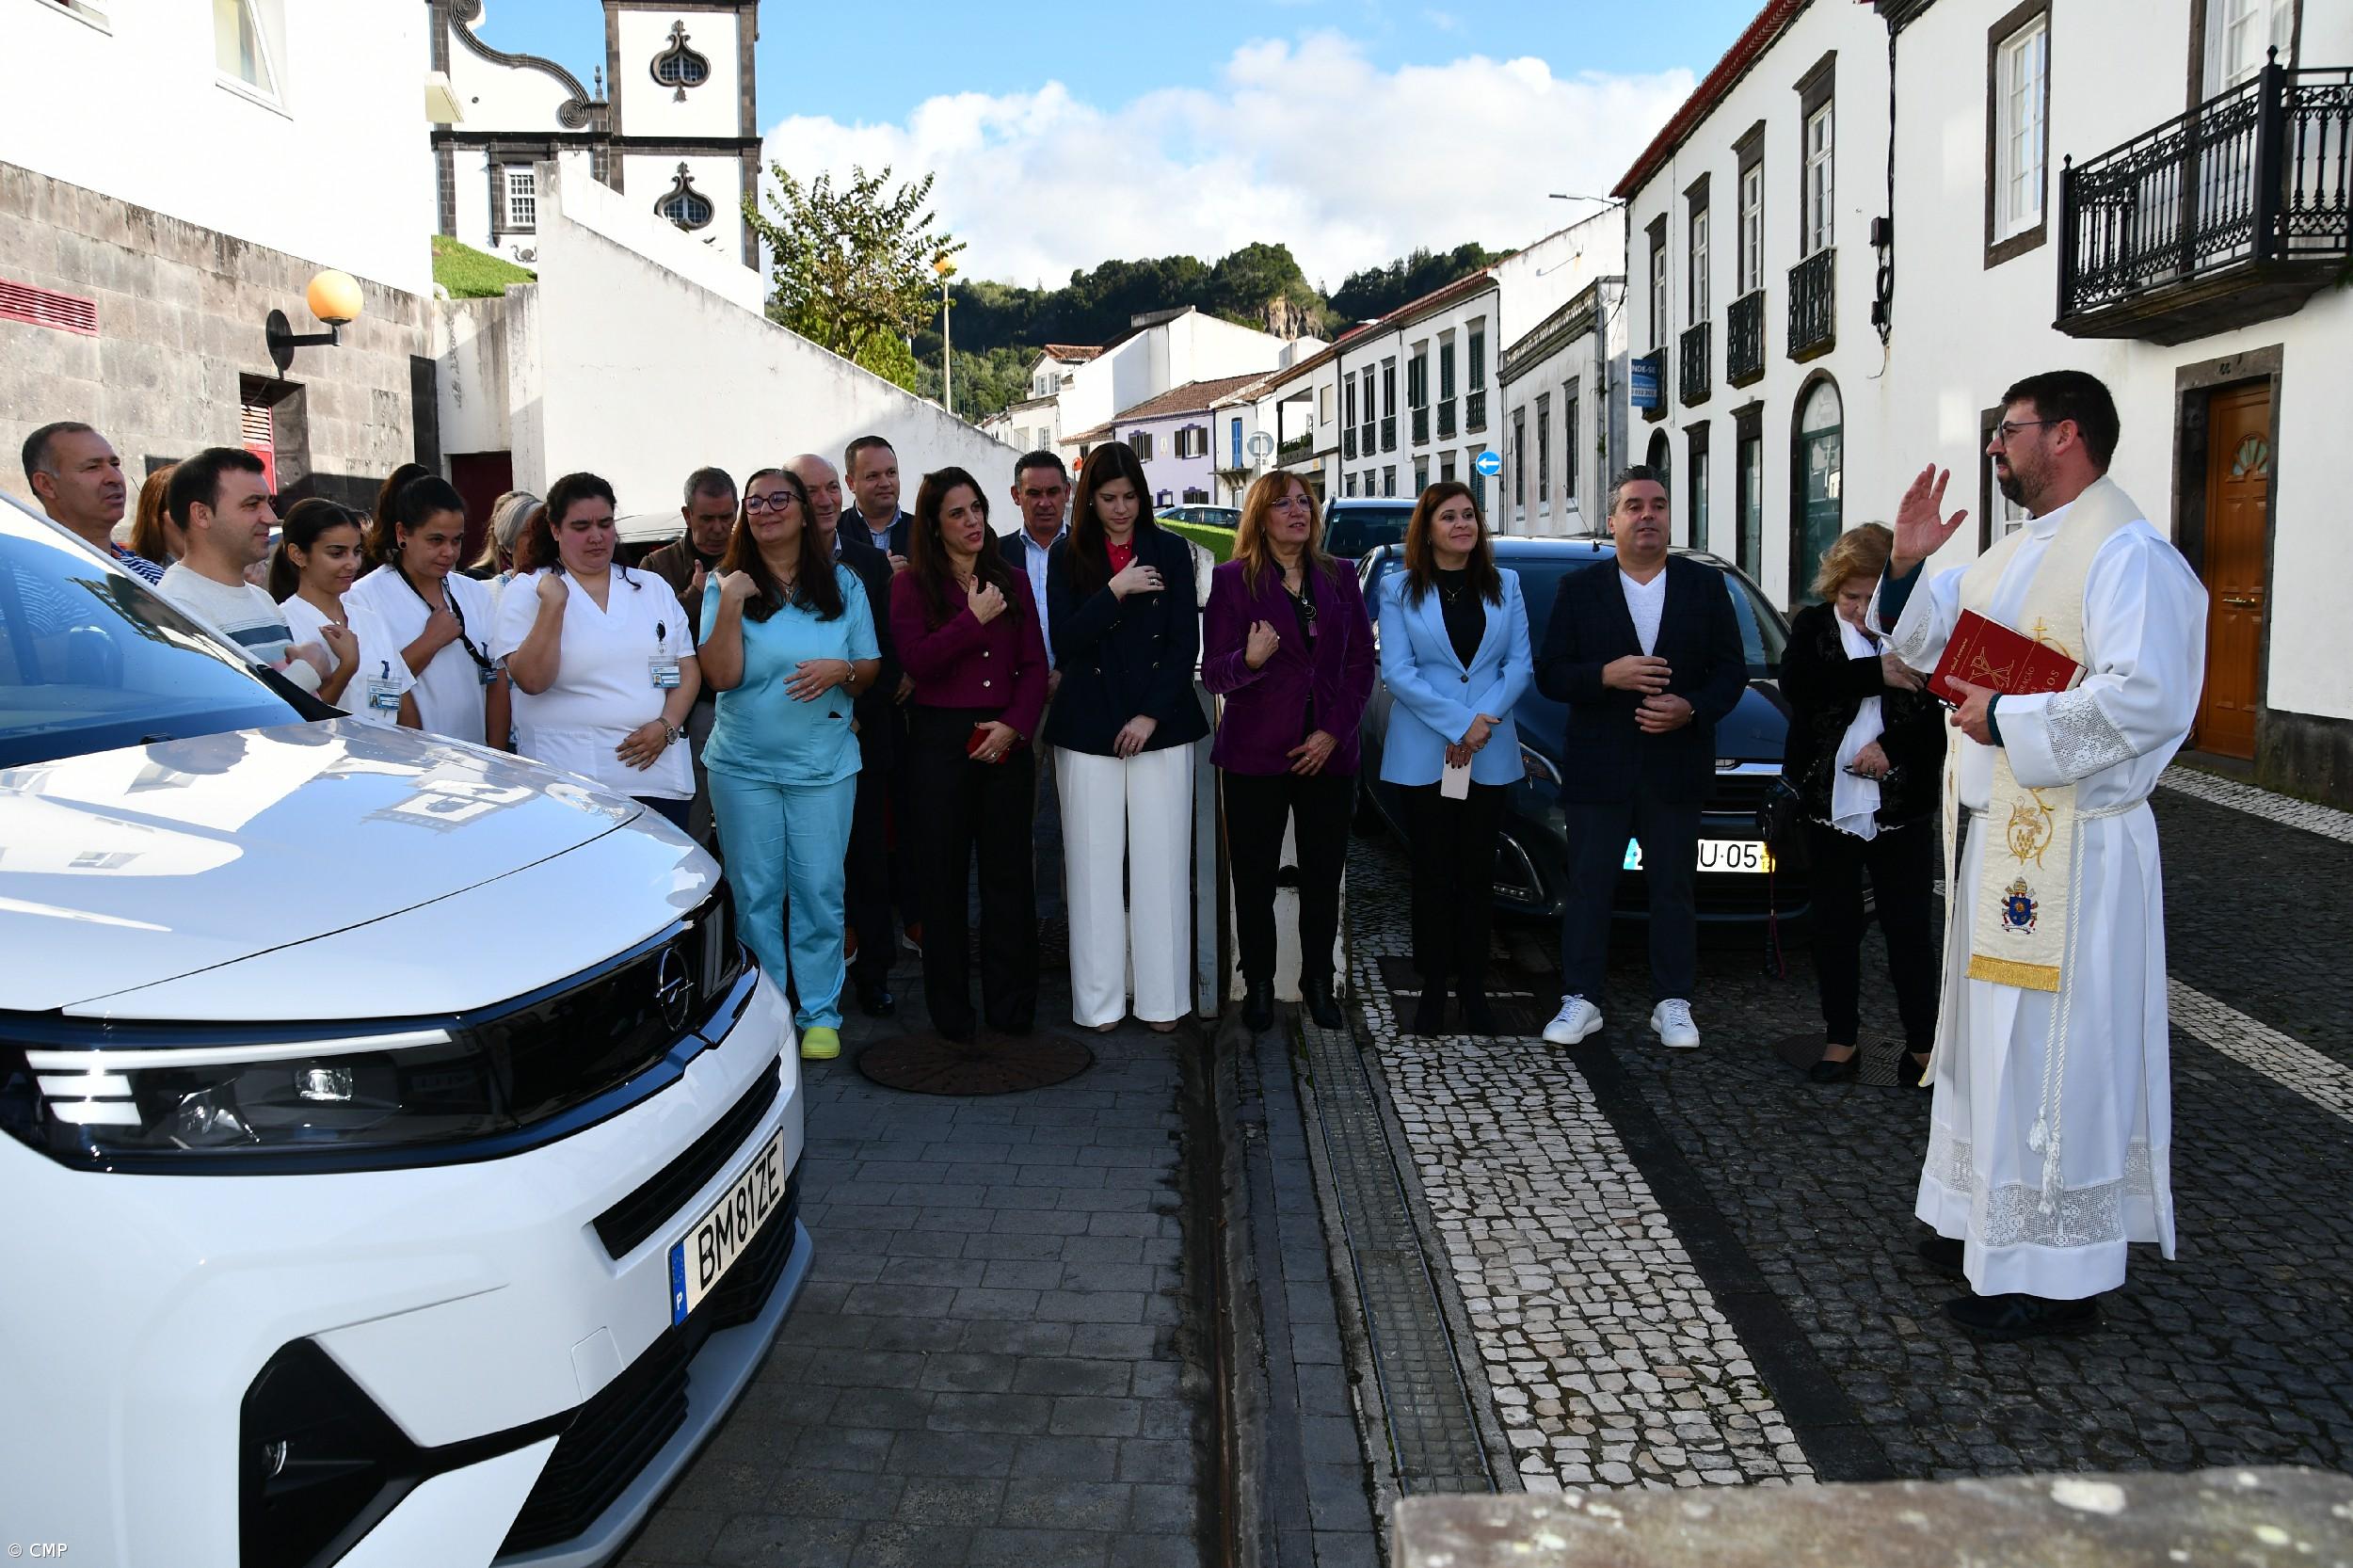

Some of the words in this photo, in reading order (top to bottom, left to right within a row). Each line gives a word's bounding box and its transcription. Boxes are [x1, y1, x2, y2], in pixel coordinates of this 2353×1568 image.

[1631, 364, 1656, 374] NDE-SE
[2017, 666, 2035, 695] BRAÇÃO
[676, 1291, 683, 1311] P
